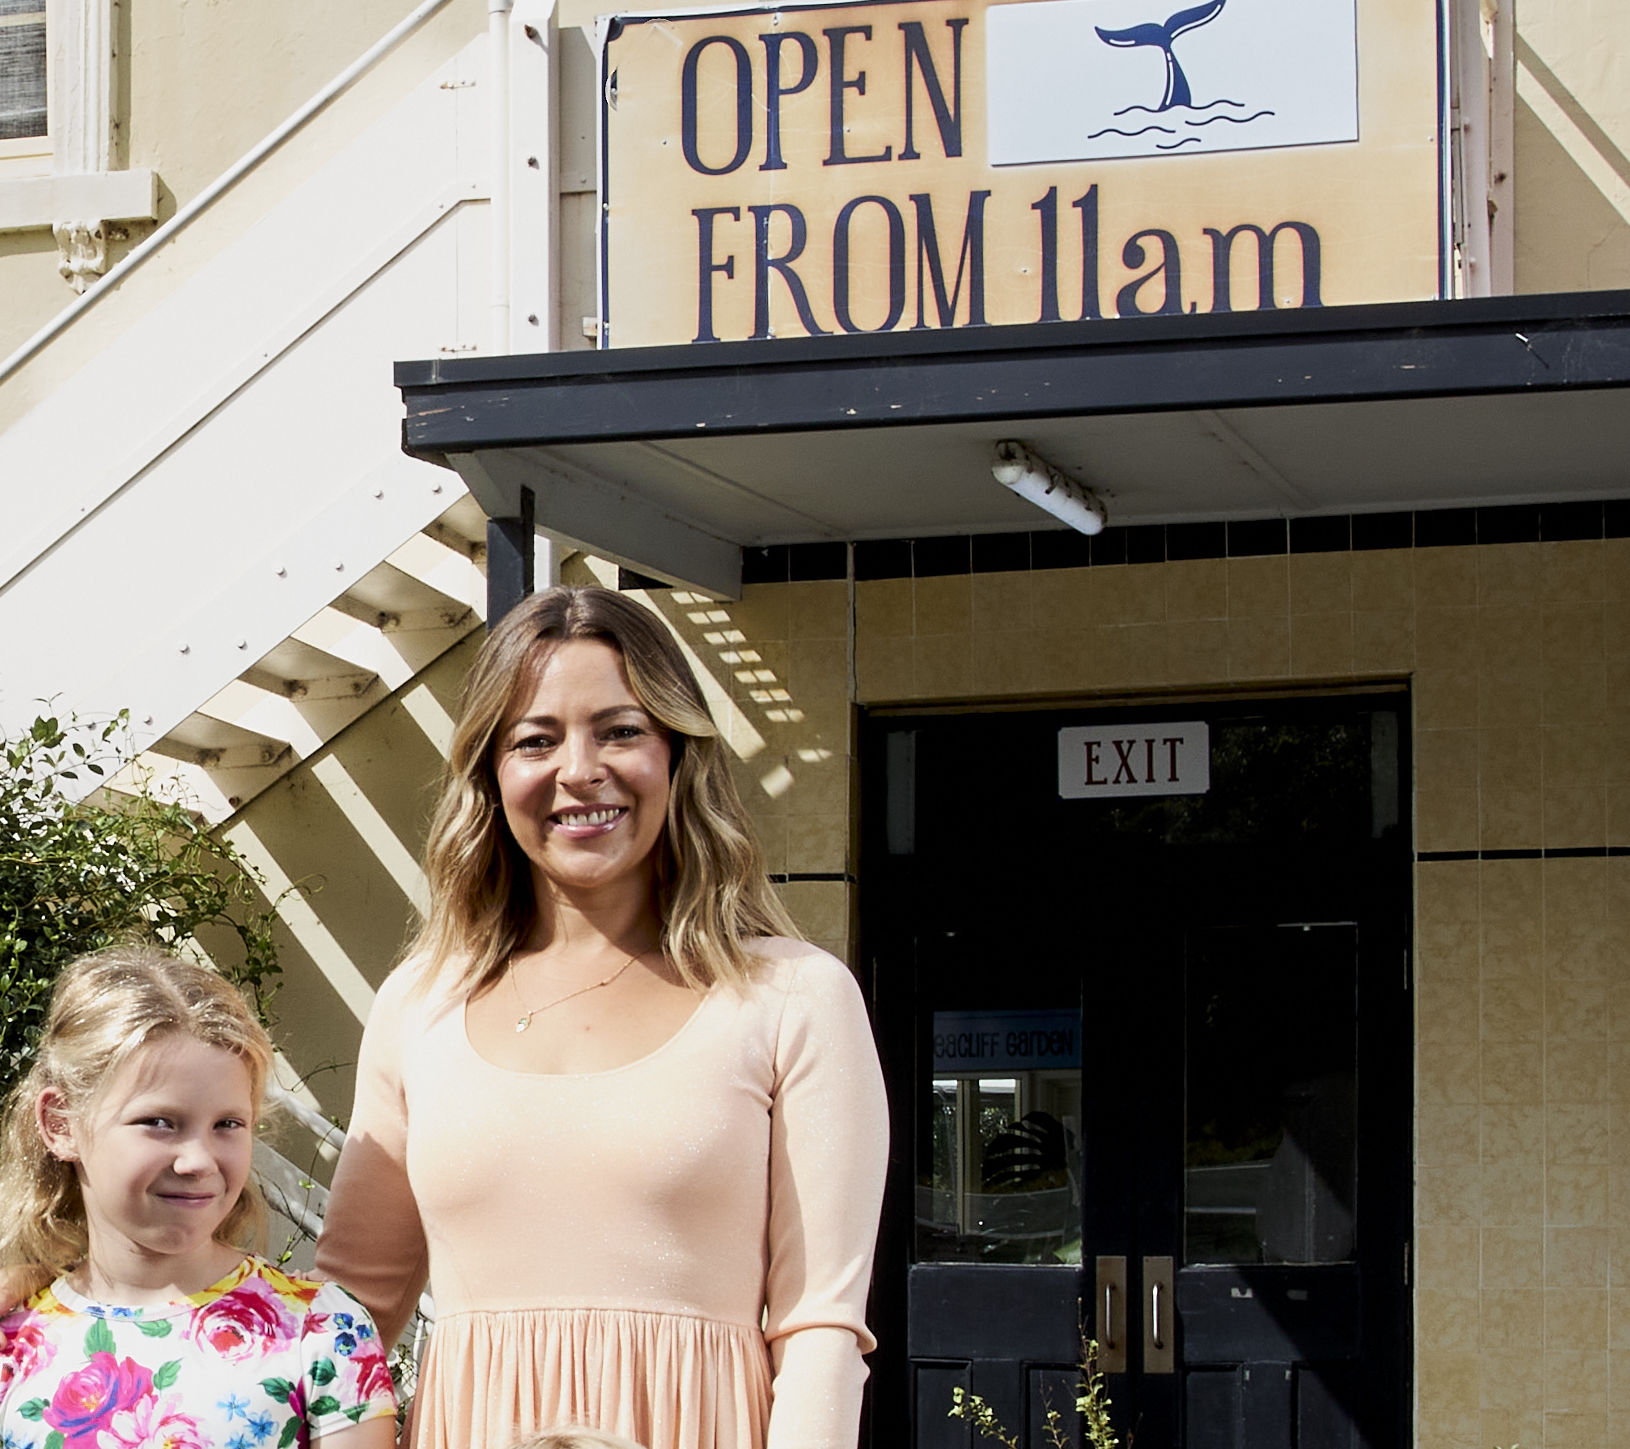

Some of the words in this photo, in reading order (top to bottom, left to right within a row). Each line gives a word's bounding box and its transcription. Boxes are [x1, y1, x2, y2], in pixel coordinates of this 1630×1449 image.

[681, 18, 969, 177] OPEN
[691, 189, 993, 343] FROM
[1030, 183, 1326, 325] 11am
[1084, 736, 1184, 785] EXIT
